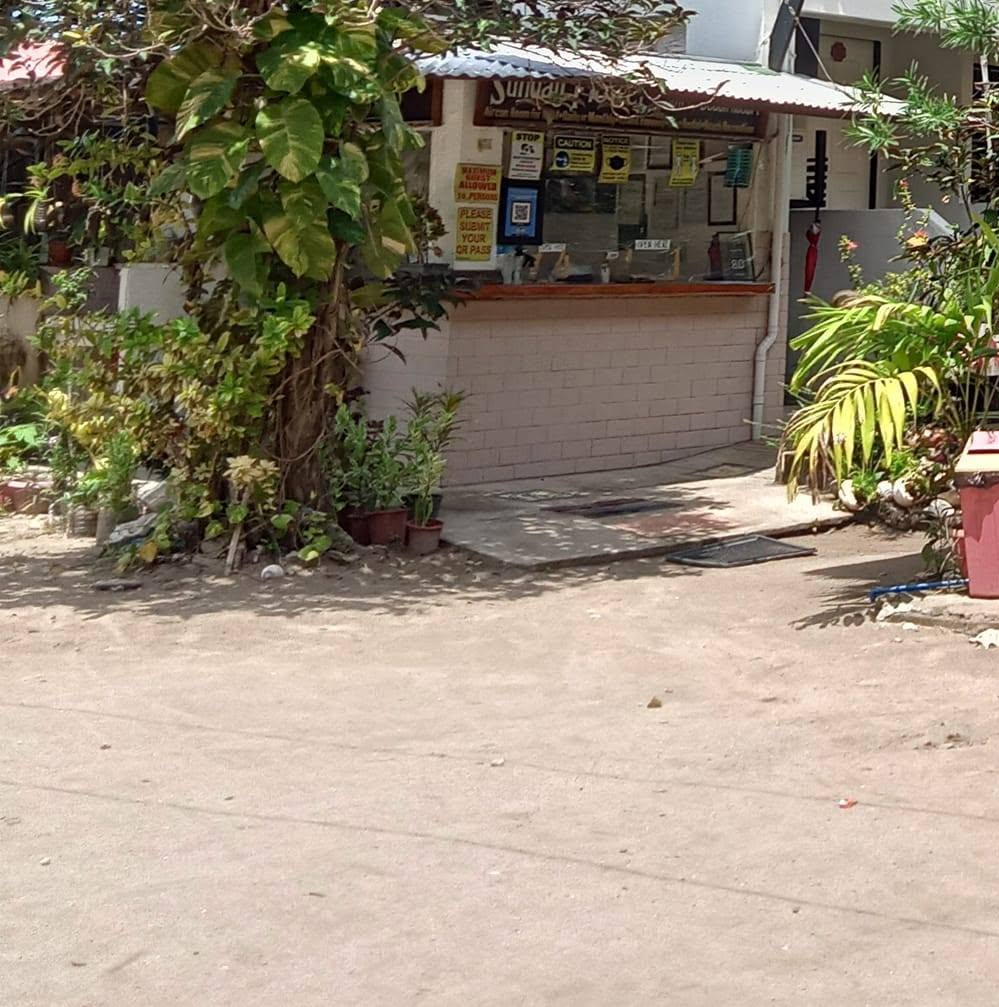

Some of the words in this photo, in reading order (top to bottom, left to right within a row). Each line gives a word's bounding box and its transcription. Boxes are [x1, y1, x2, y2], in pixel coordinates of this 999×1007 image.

[516, 133, 540, 142] STOP
[603, 136, 629, 145] NOTICE
[557, 138, 593, 149] CAUTION
[462, 167, 497, 176] MAXIMUM
[465, 174, 490, 182] GUEST
[458, 181, 497, 191] ALLOWED
[459, 207, 492, 218] PLEASE
[459, 221, 490, 232] SUBMIT
[461, 234, 486, 244] YOUR
[470, 245, 492, 256] PASS
